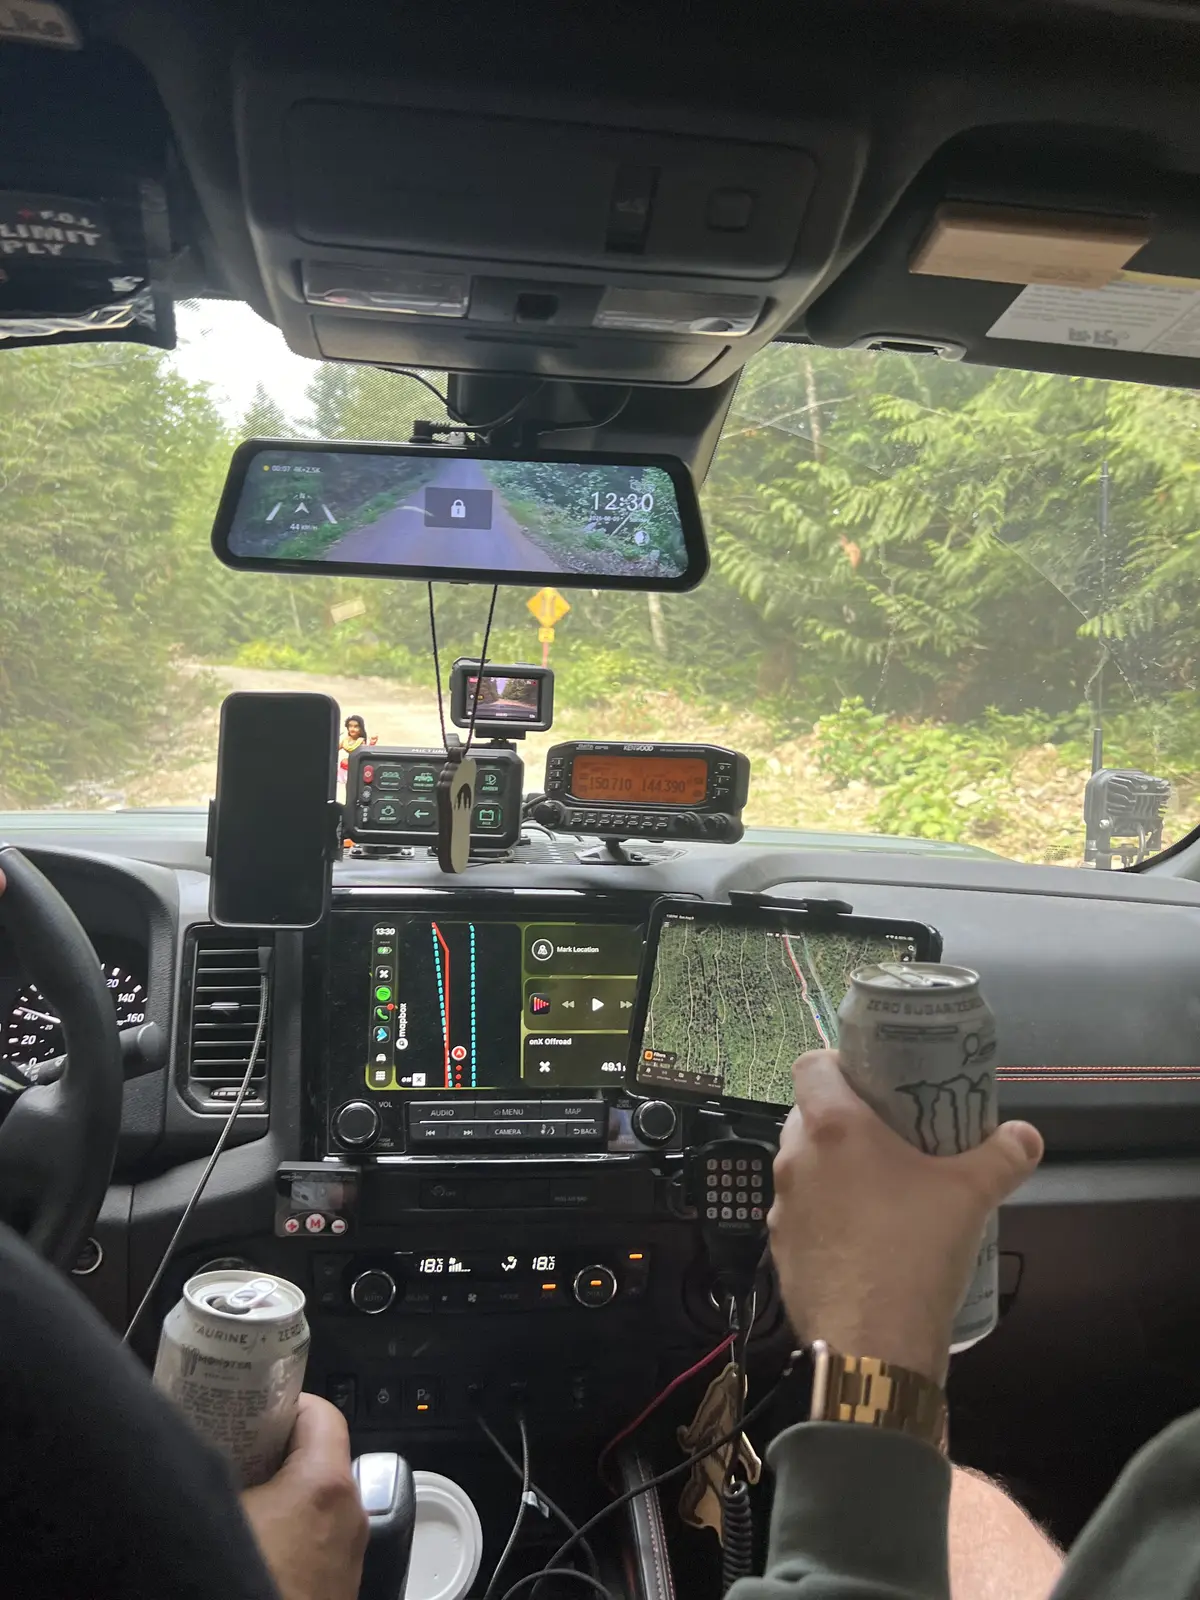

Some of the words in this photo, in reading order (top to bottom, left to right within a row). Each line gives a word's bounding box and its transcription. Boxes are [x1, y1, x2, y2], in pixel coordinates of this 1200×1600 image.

[591, 491, 653, 512] 12:30
[589, 777, 632, 791] 150.710
[642, 778, 687, 793] 144.390
[376, 927, 396, 935] 13:30
[117, 993, 136, 1002] 140
[866, 999, 899, 1014] ZERO
[904, 1002, 951, 1016] SUGAR
[126, 1013, 145, 1023] 160
[398, 1003, 408, 1037] mapbox
[20, 1035, 37, 1045] 20
[601, 1062, 622, 1072] 49.1
[430, 1109, 455, 1117] AUDIO
[502, 1108, 524, 1116] MENU
[310, 1219, 322, 1229] M
